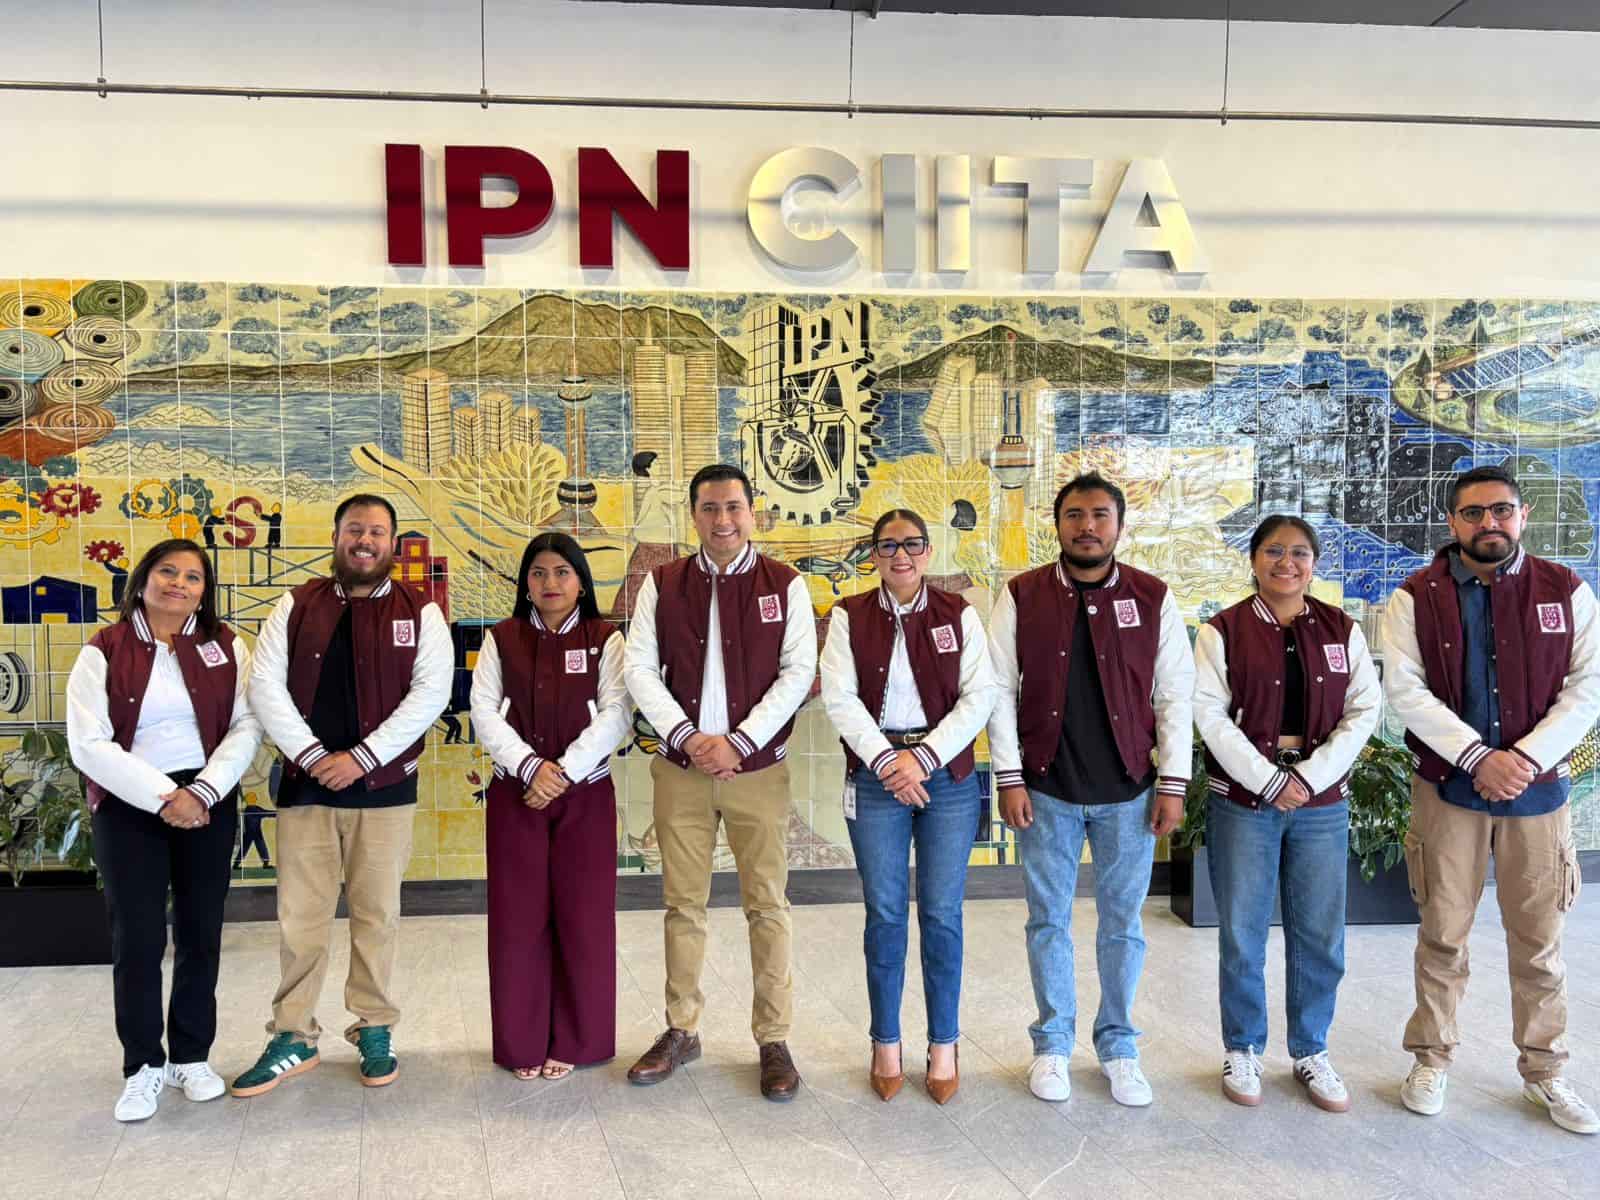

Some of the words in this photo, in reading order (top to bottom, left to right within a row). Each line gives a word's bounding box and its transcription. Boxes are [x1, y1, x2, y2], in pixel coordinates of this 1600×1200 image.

[385, 143, 690, 271] IPN
[747, 145, 1208, 273] CIITA
[783, 302, 870, 367] IPN
[223, 495, 263, 548] S
